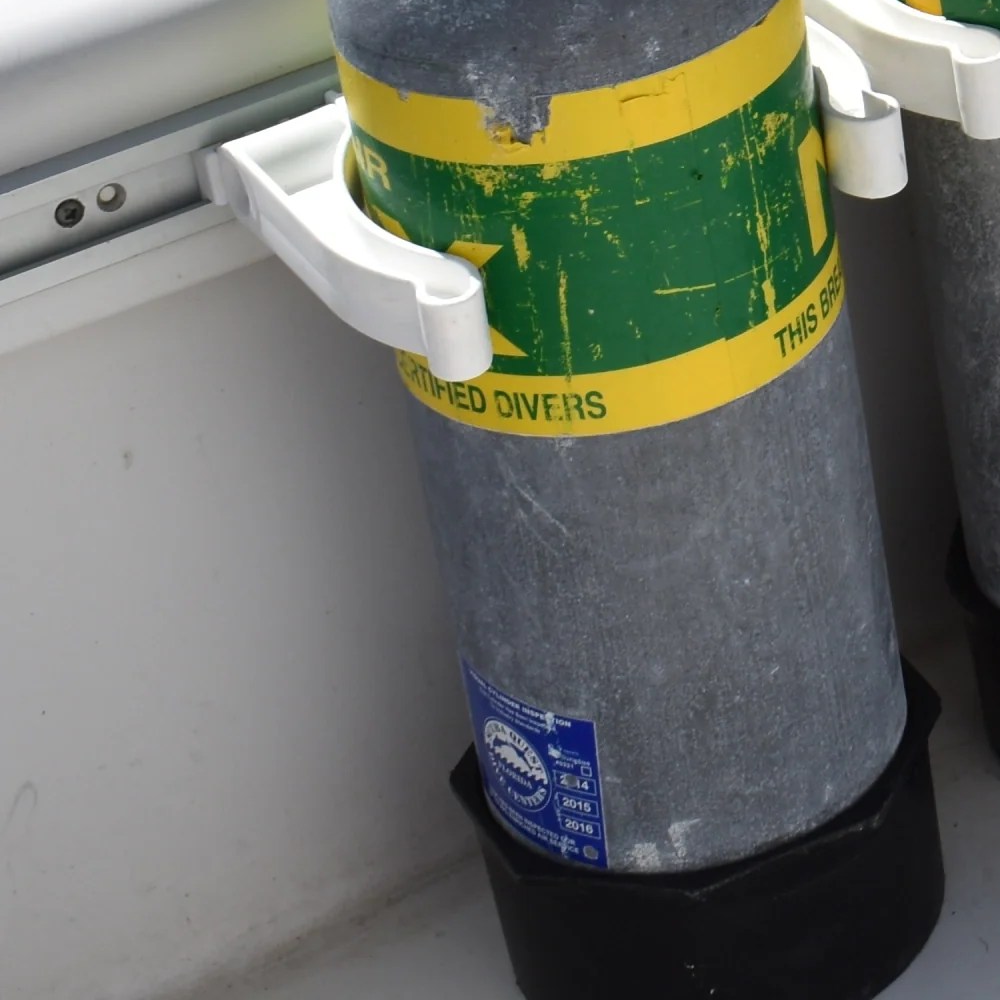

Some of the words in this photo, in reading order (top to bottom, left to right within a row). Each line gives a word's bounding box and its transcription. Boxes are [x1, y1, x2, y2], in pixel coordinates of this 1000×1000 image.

[774, 303, 818, 358] THIS
[497, 390, 607, 421] DIVERS
[521, 706, 572, 728] INSPETION
[560, 775, 589, 791] 214
[562, 797, 592, 813] 2015
[565, 818, 594, 834] 2016
